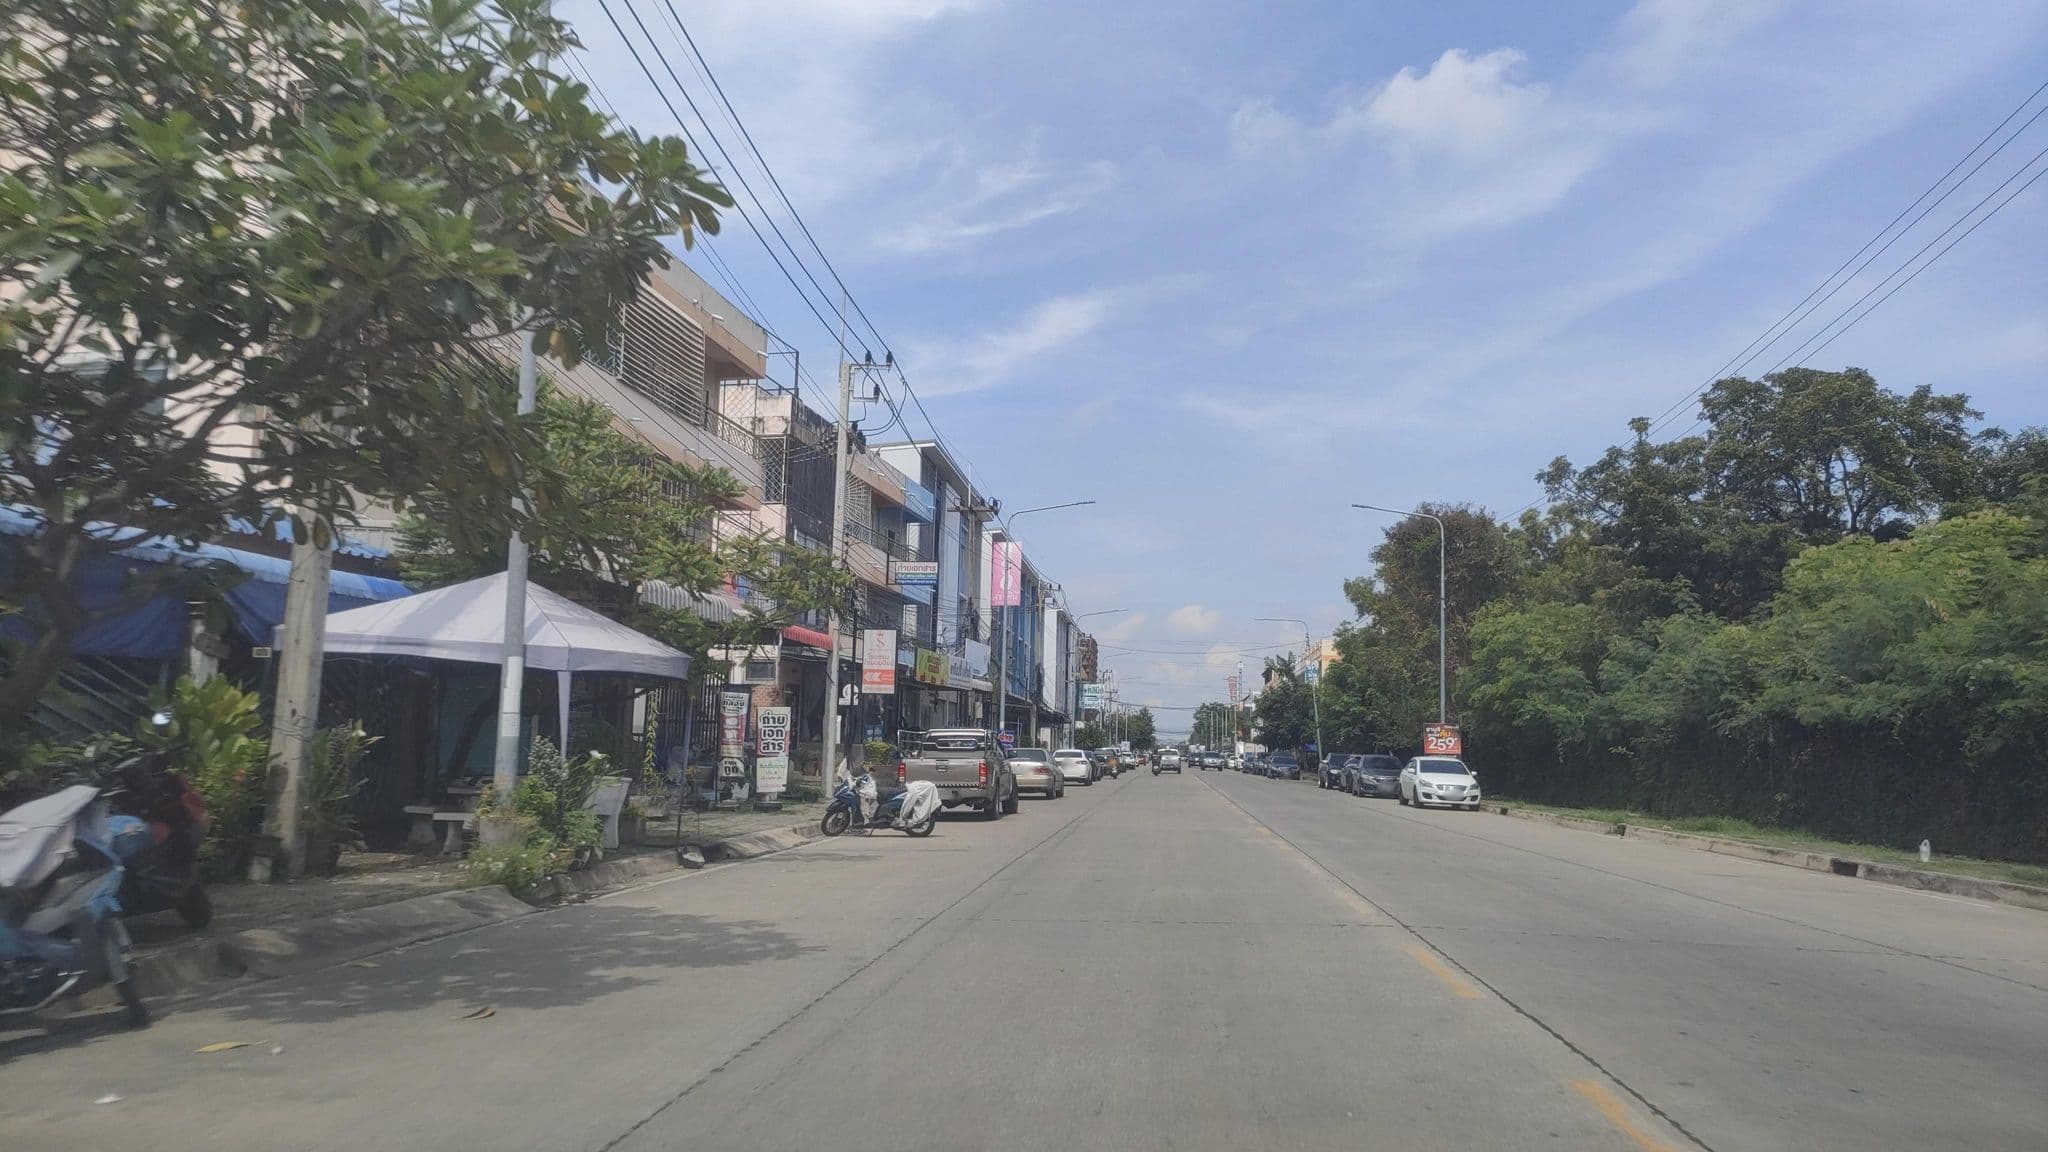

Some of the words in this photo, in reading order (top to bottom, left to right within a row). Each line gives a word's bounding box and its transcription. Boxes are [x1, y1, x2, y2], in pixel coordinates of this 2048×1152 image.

[897, 562, 937, 572] ถ่ายเอกสาร
[762, 711, 786, 725] ถ่าย
[762, 728, 784, 738] เอก
[762, 740, 784, 751] สาร
[1428, 737, 1455, 751] 259
